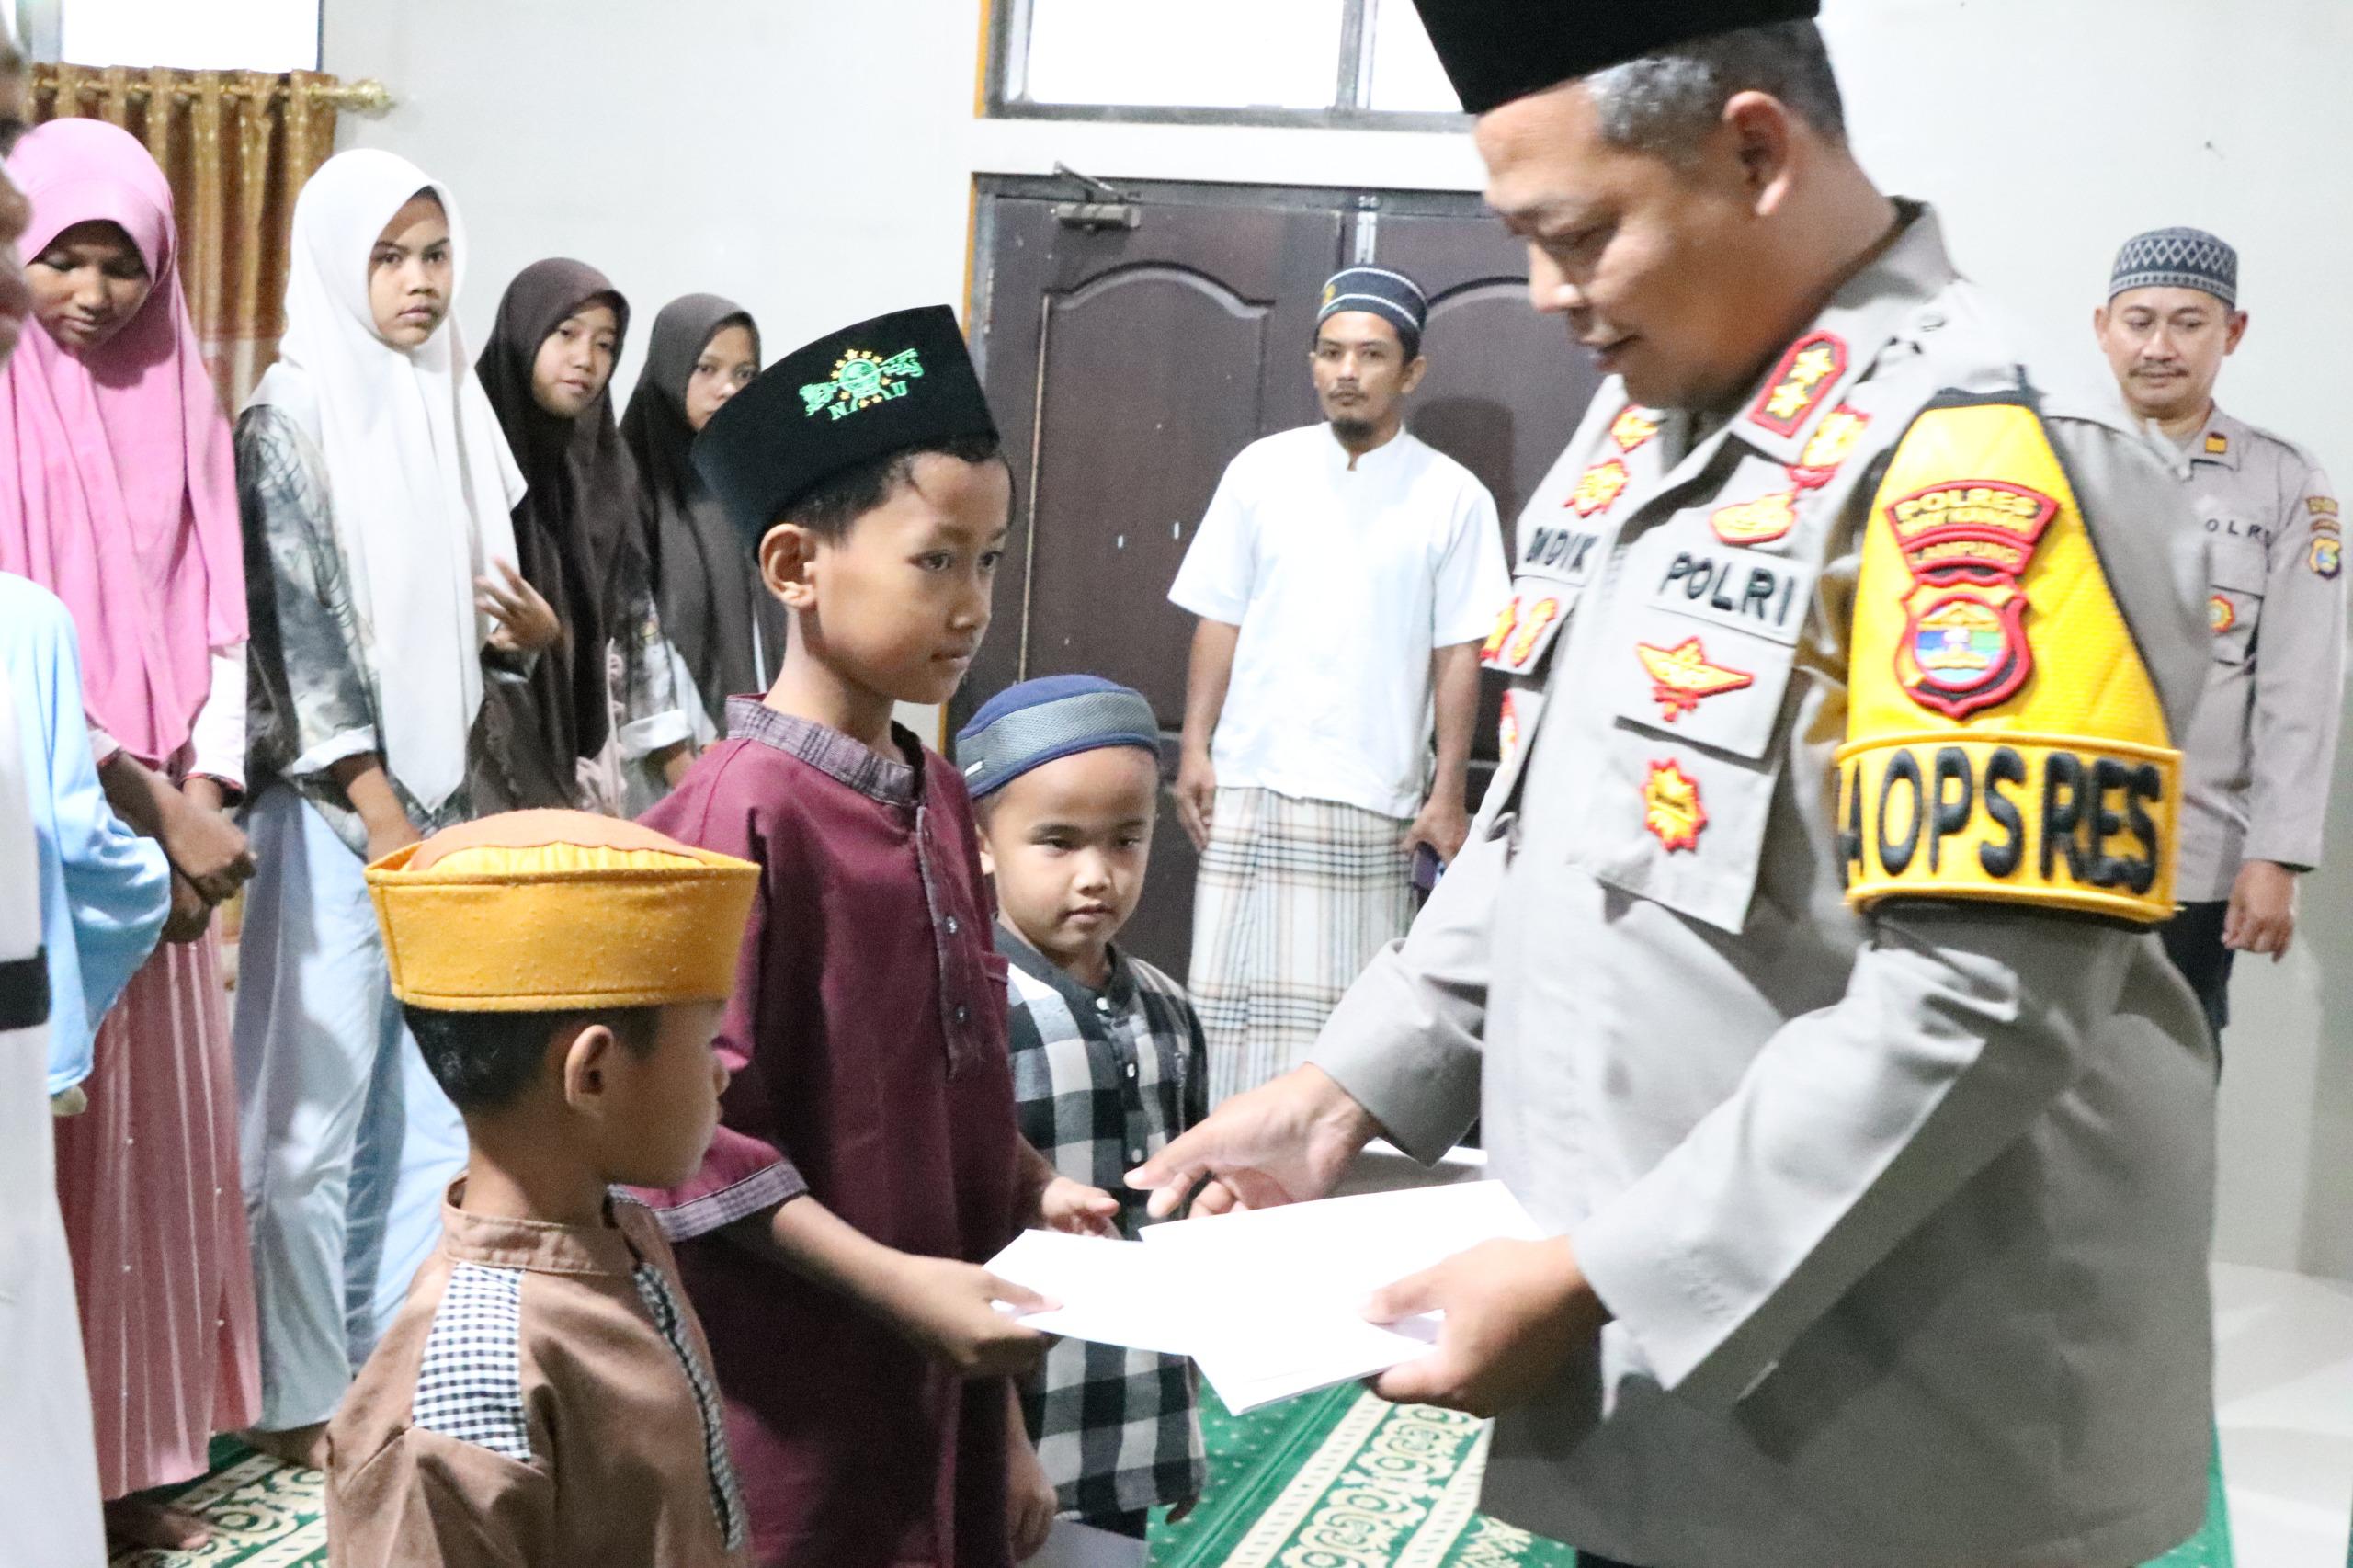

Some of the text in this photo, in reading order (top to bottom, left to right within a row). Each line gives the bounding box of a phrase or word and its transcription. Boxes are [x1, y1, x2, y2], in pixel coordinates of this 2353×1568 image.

[1894, 487, 2039, 525] POLRES
[2205, 518, 2270, 549] OLRI
[1659, 551, 1798, 627] POLRI
